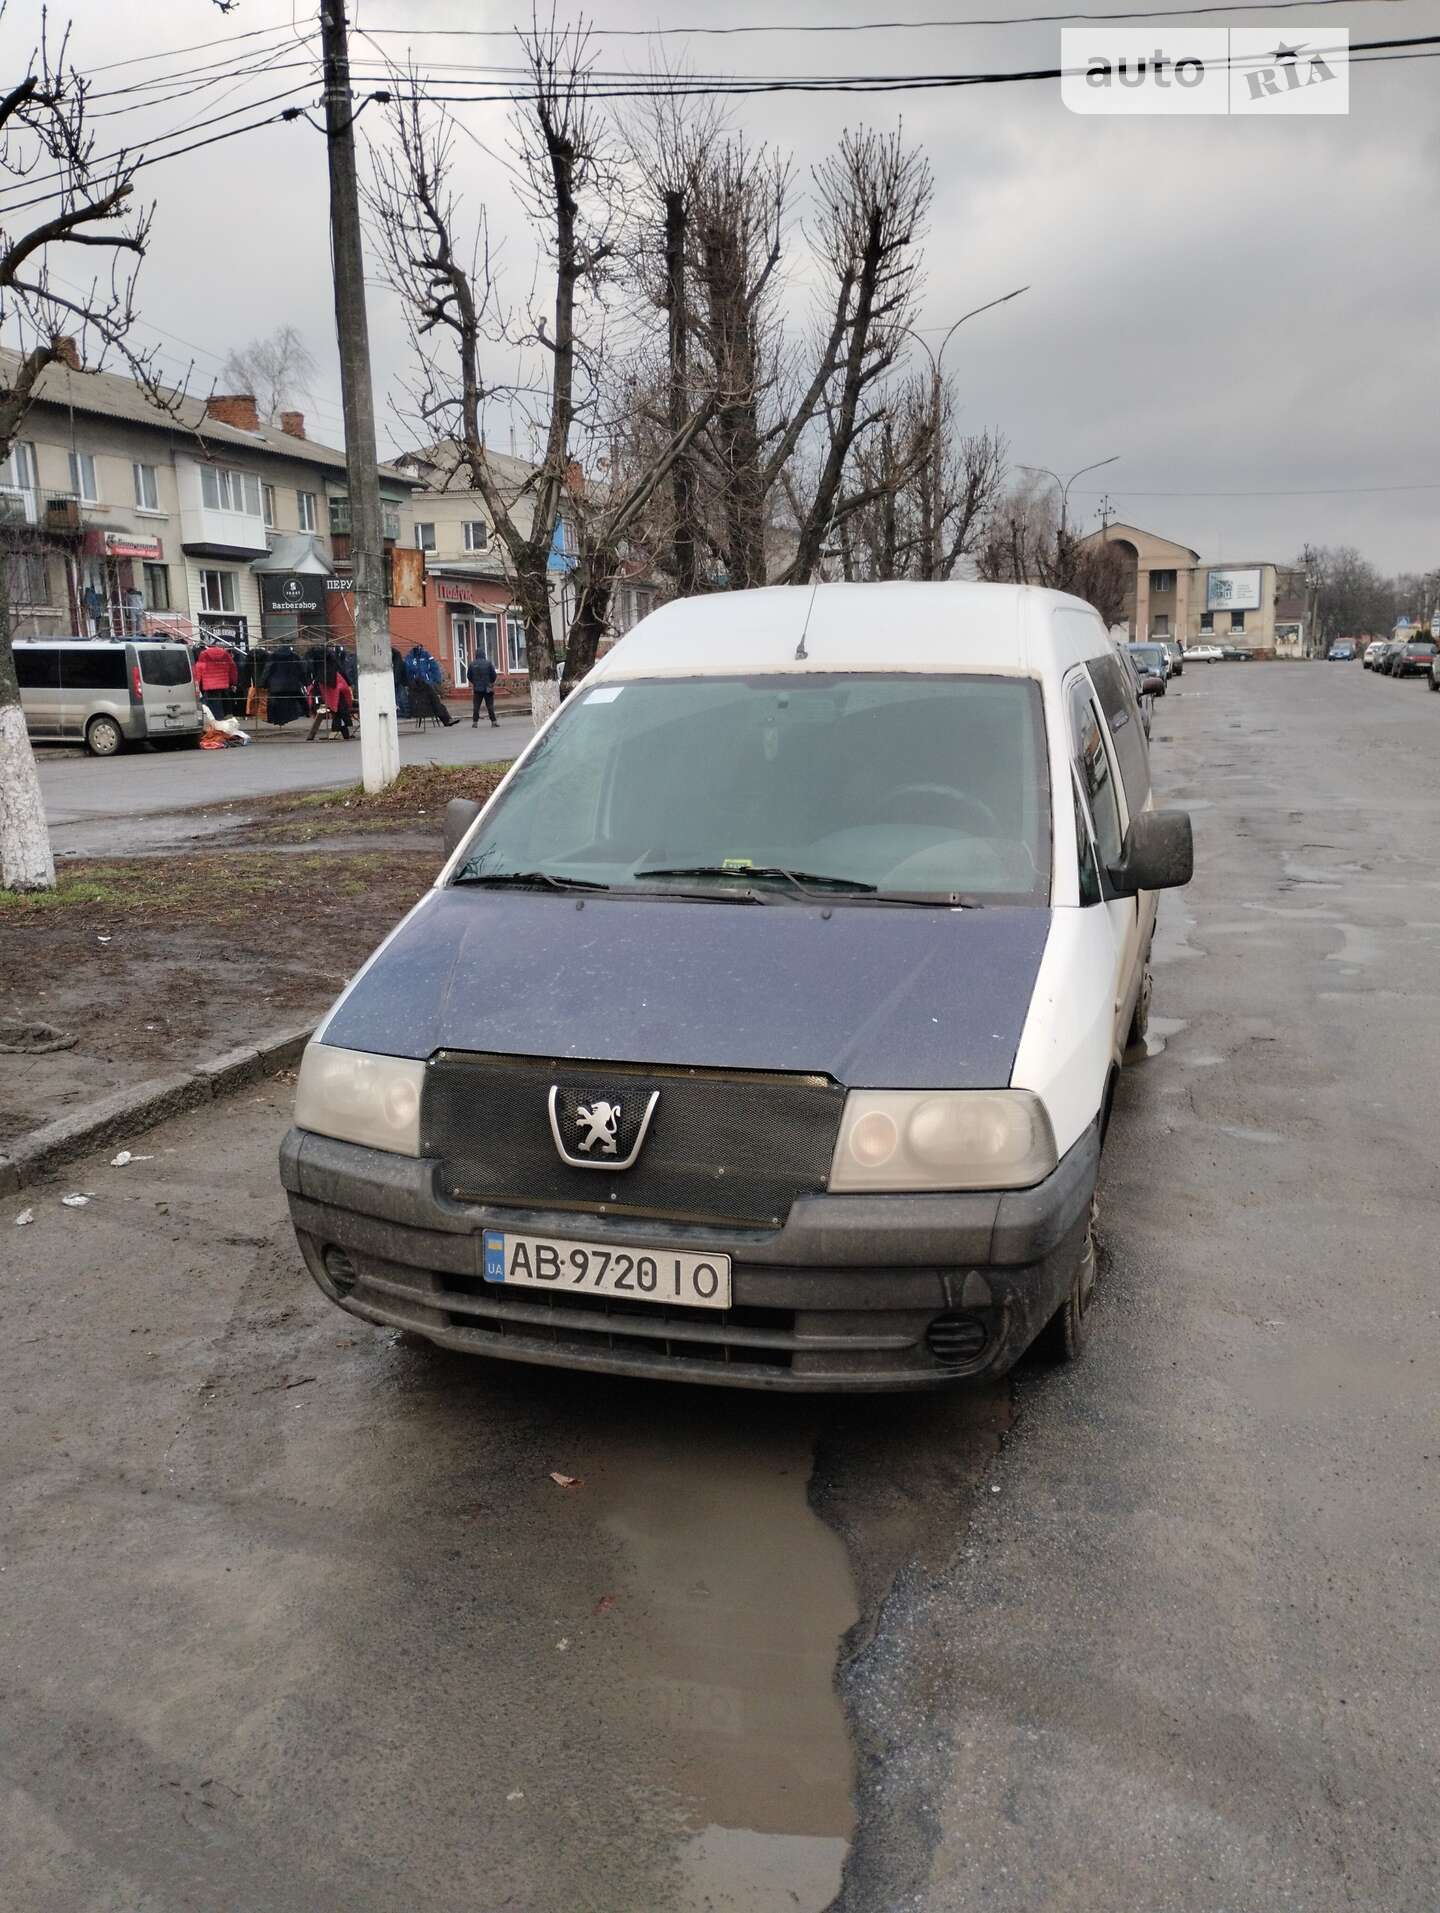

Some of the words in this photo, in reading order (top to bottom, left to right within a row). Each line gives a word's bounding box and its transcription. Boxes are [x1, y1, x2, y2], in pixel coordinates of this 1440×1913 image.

[327, 580, 353, 589] ПЕРУ
[487, 1263, 502, 1275] UA
[509, 1242, 561, 1280] AB
[569, 1249, 657, 1292] 9720
